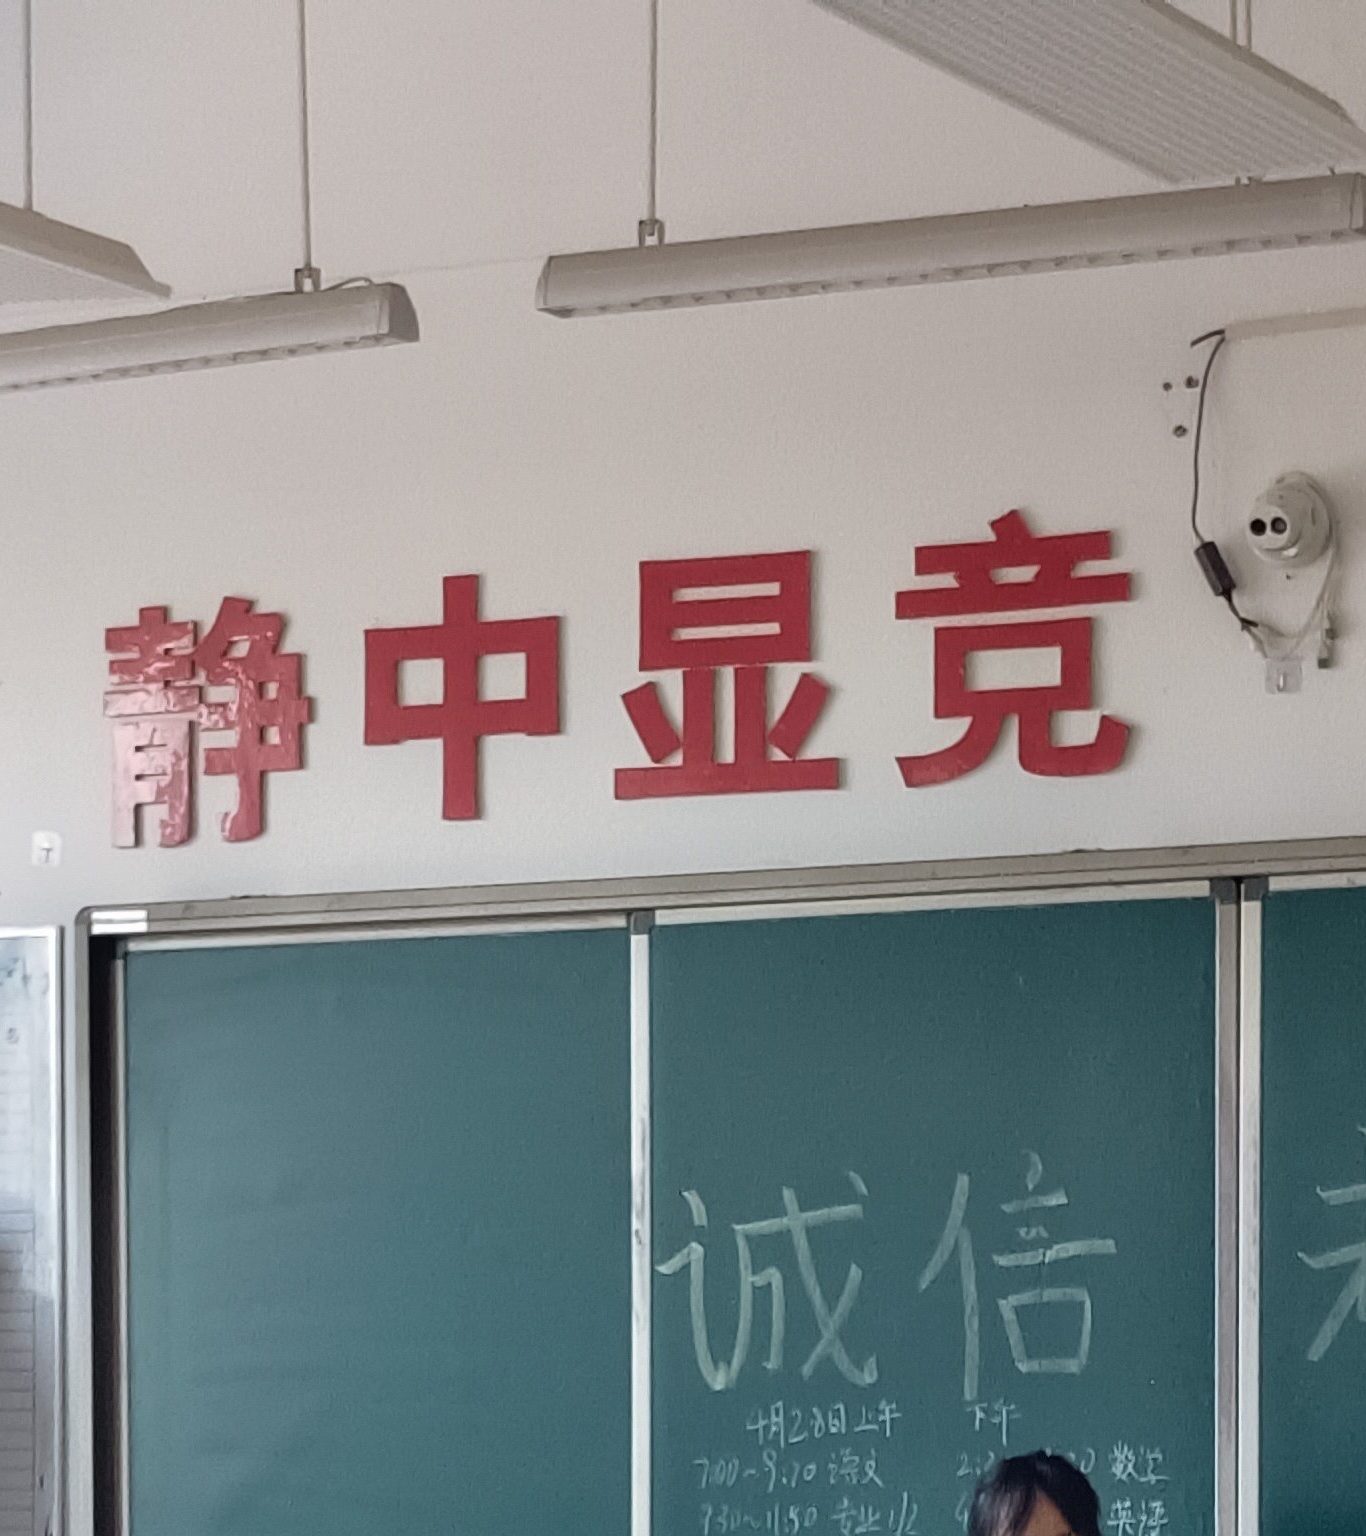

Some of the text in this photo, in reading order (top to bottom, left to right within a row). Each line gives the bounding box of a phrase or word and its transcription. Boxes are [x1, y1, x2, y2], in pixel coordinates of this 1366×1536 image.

[103, 510, 1133, 848] 静中显竞
[655, 1149, 1117, 1401] 诚信
[966, 1398, 1022, 1447] 下午
[1109, 1440, 1171, 1485] 数学
